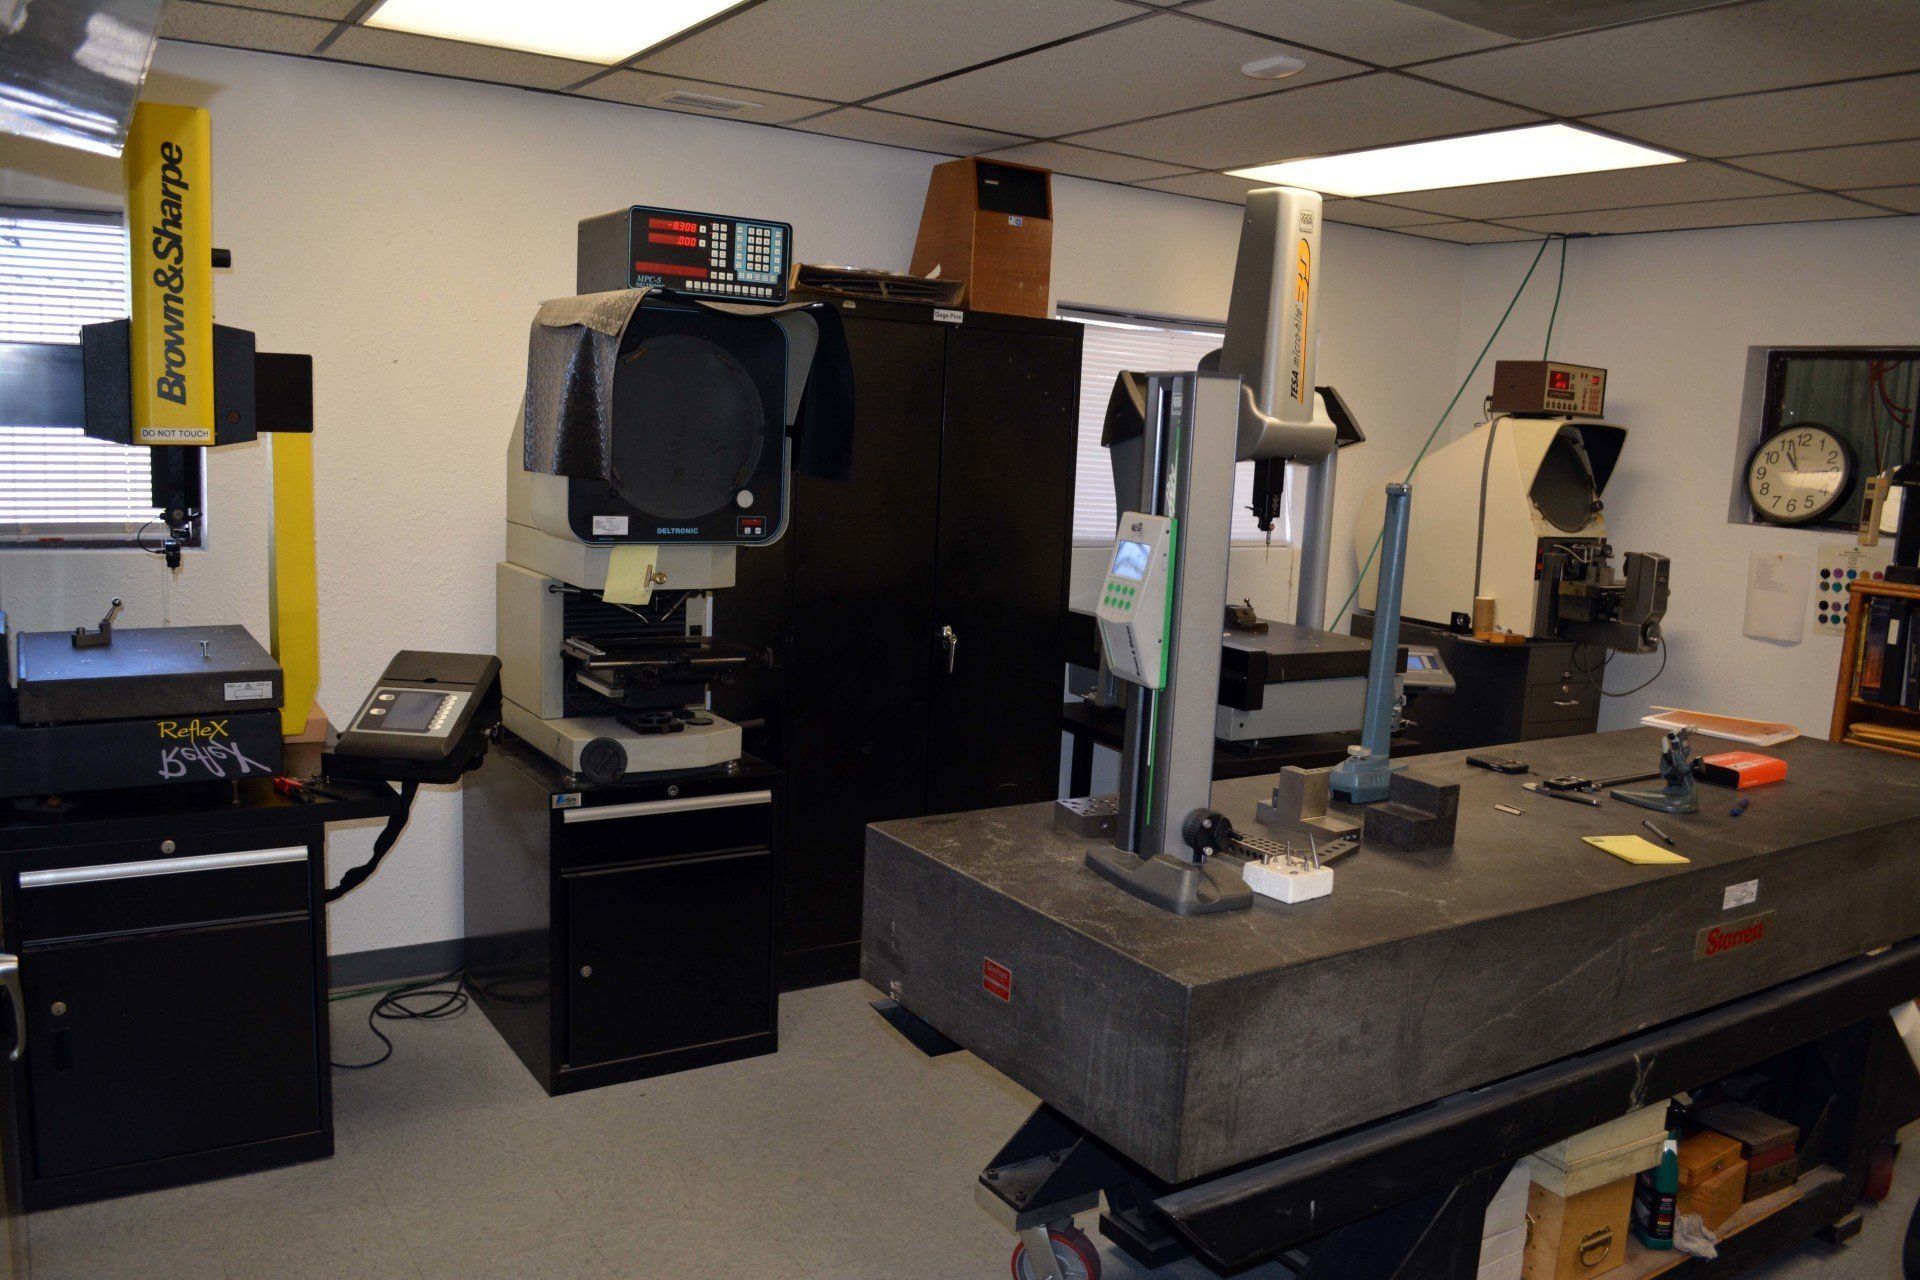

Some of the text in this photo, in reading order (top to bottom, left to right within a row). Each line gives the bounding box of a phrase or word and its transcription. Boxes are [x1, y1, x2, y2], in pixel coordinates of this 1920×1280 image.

[152, 141, 189, 406] Brown&Sharpe
[1290, 371, 1300, 400] TESA
[142, 429, 156, 437] DO
[1797, 433, 1812, 447] 12
[1820, 438, 1826, 451] 1
[1765, 451, 1779, 464] 10
[1827, 451, 1838, 464] 2
[1756, 467, 1766, 479] 9
[1760, 482, 1770, 495] 8
[1772, 496, 1782, 509] 7
[1786, 499, 1797, 513] 6
[1804, 495, 1814, 508] 5
[1705, 921, 1763, 956] Starrett
